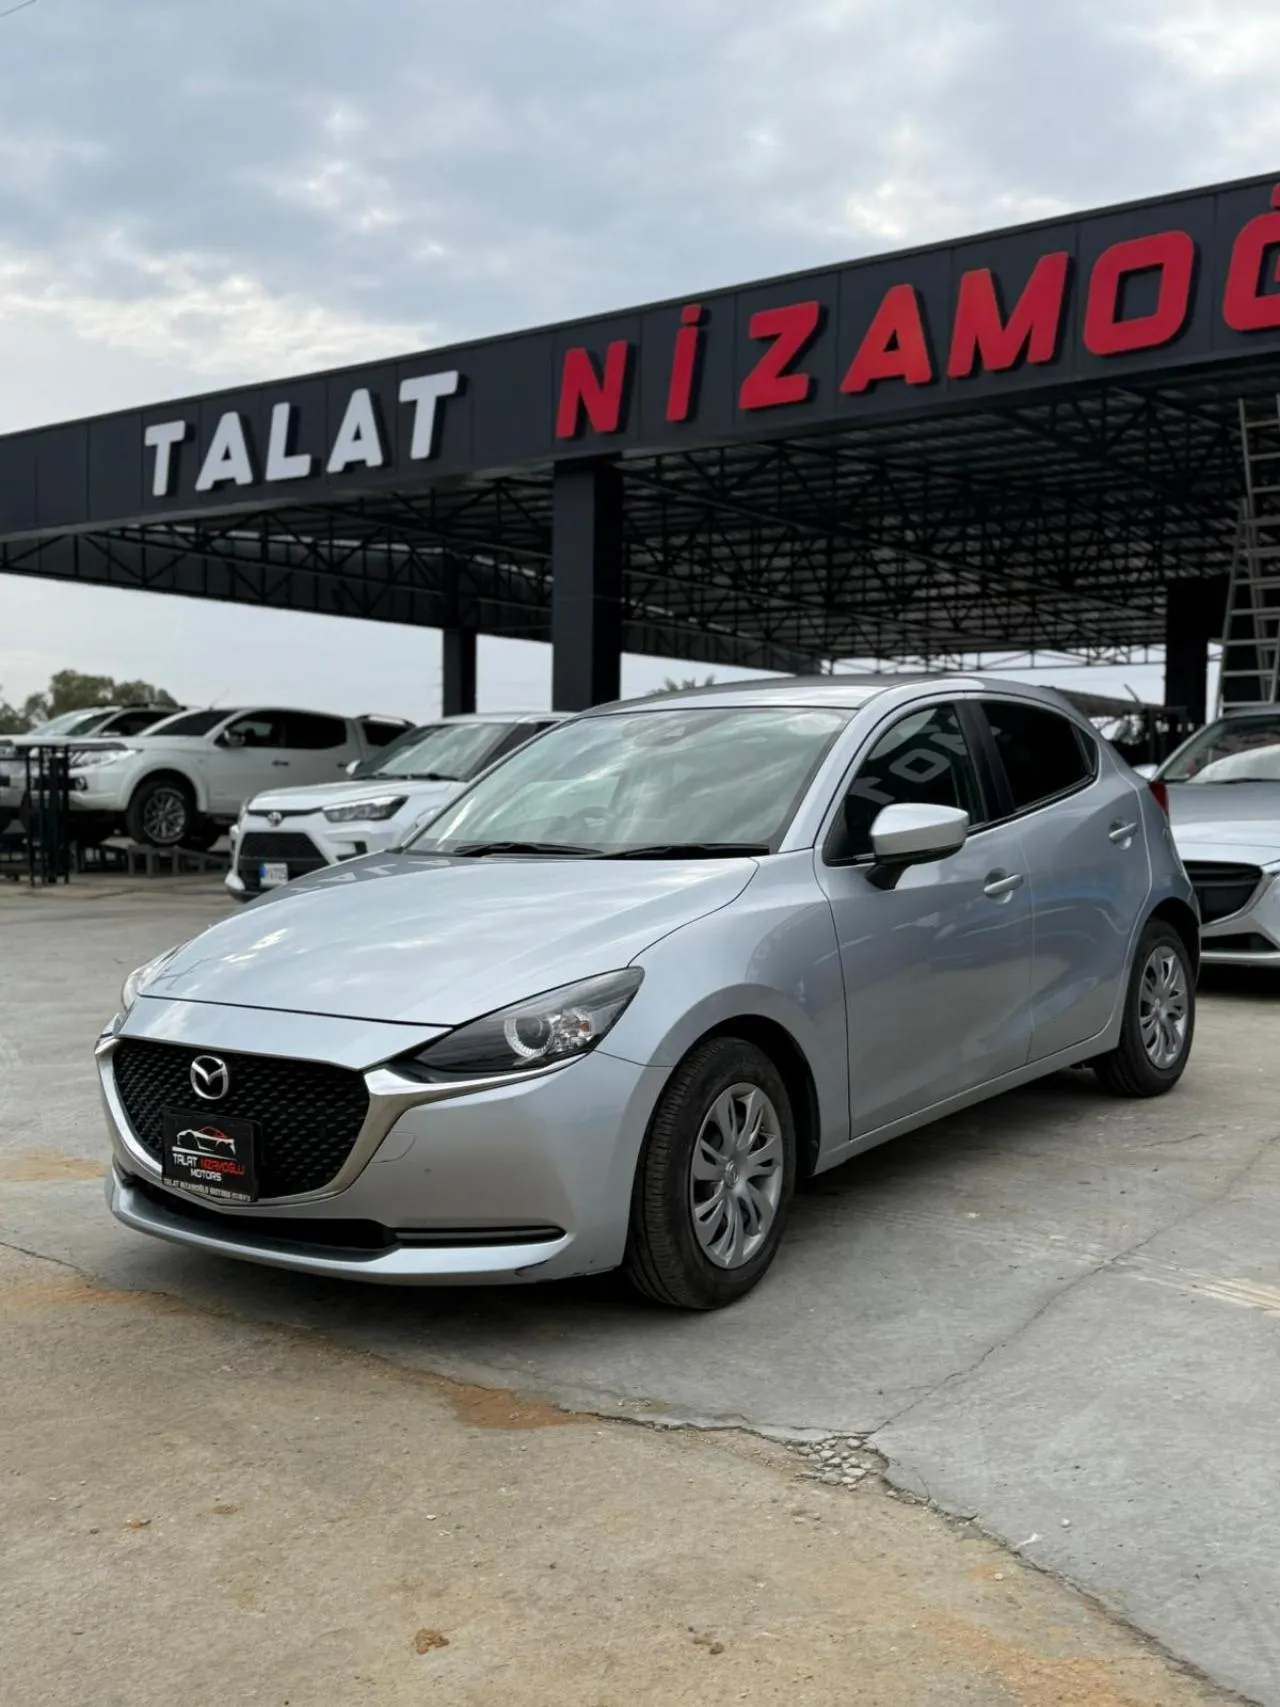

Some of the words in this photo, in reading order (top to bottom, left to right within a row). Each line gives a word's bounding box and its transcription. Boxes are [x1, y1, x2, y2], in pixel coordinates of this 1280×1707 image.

[145, 371, 459, 496] TALAT
[172, 1153, 198, 1167] TALAT
[190, 1168, 222, 1182] MOTORS
